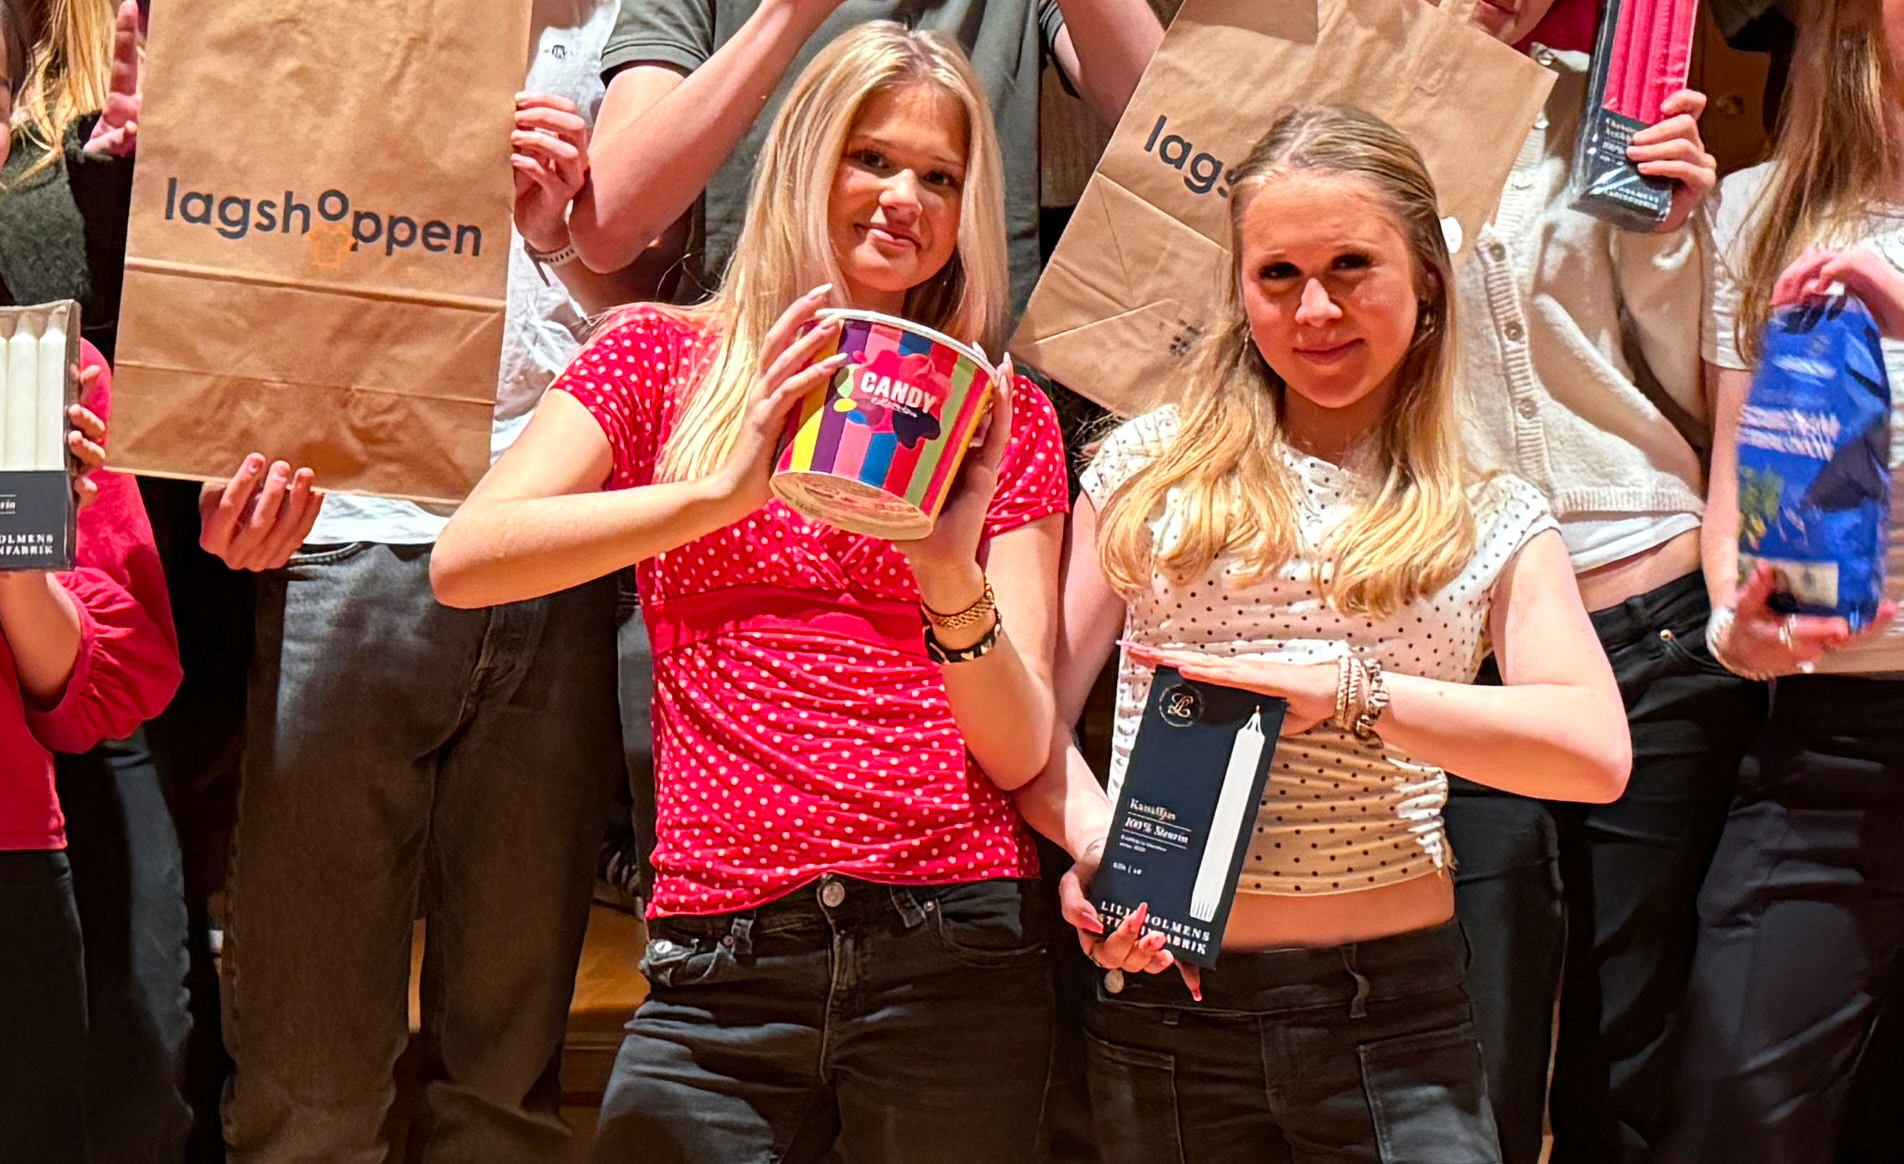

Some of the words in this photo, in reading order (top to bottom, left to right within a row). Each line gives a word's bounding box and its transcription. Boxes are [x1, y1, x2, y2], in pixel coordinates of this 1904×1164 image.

[165, 178, 482, 257] lagshoppen
[860, 371, 939, 414] CANDY
[1124, 816, 1152, 835] 100%
[1153, 824, 1189, 845] Stearin
